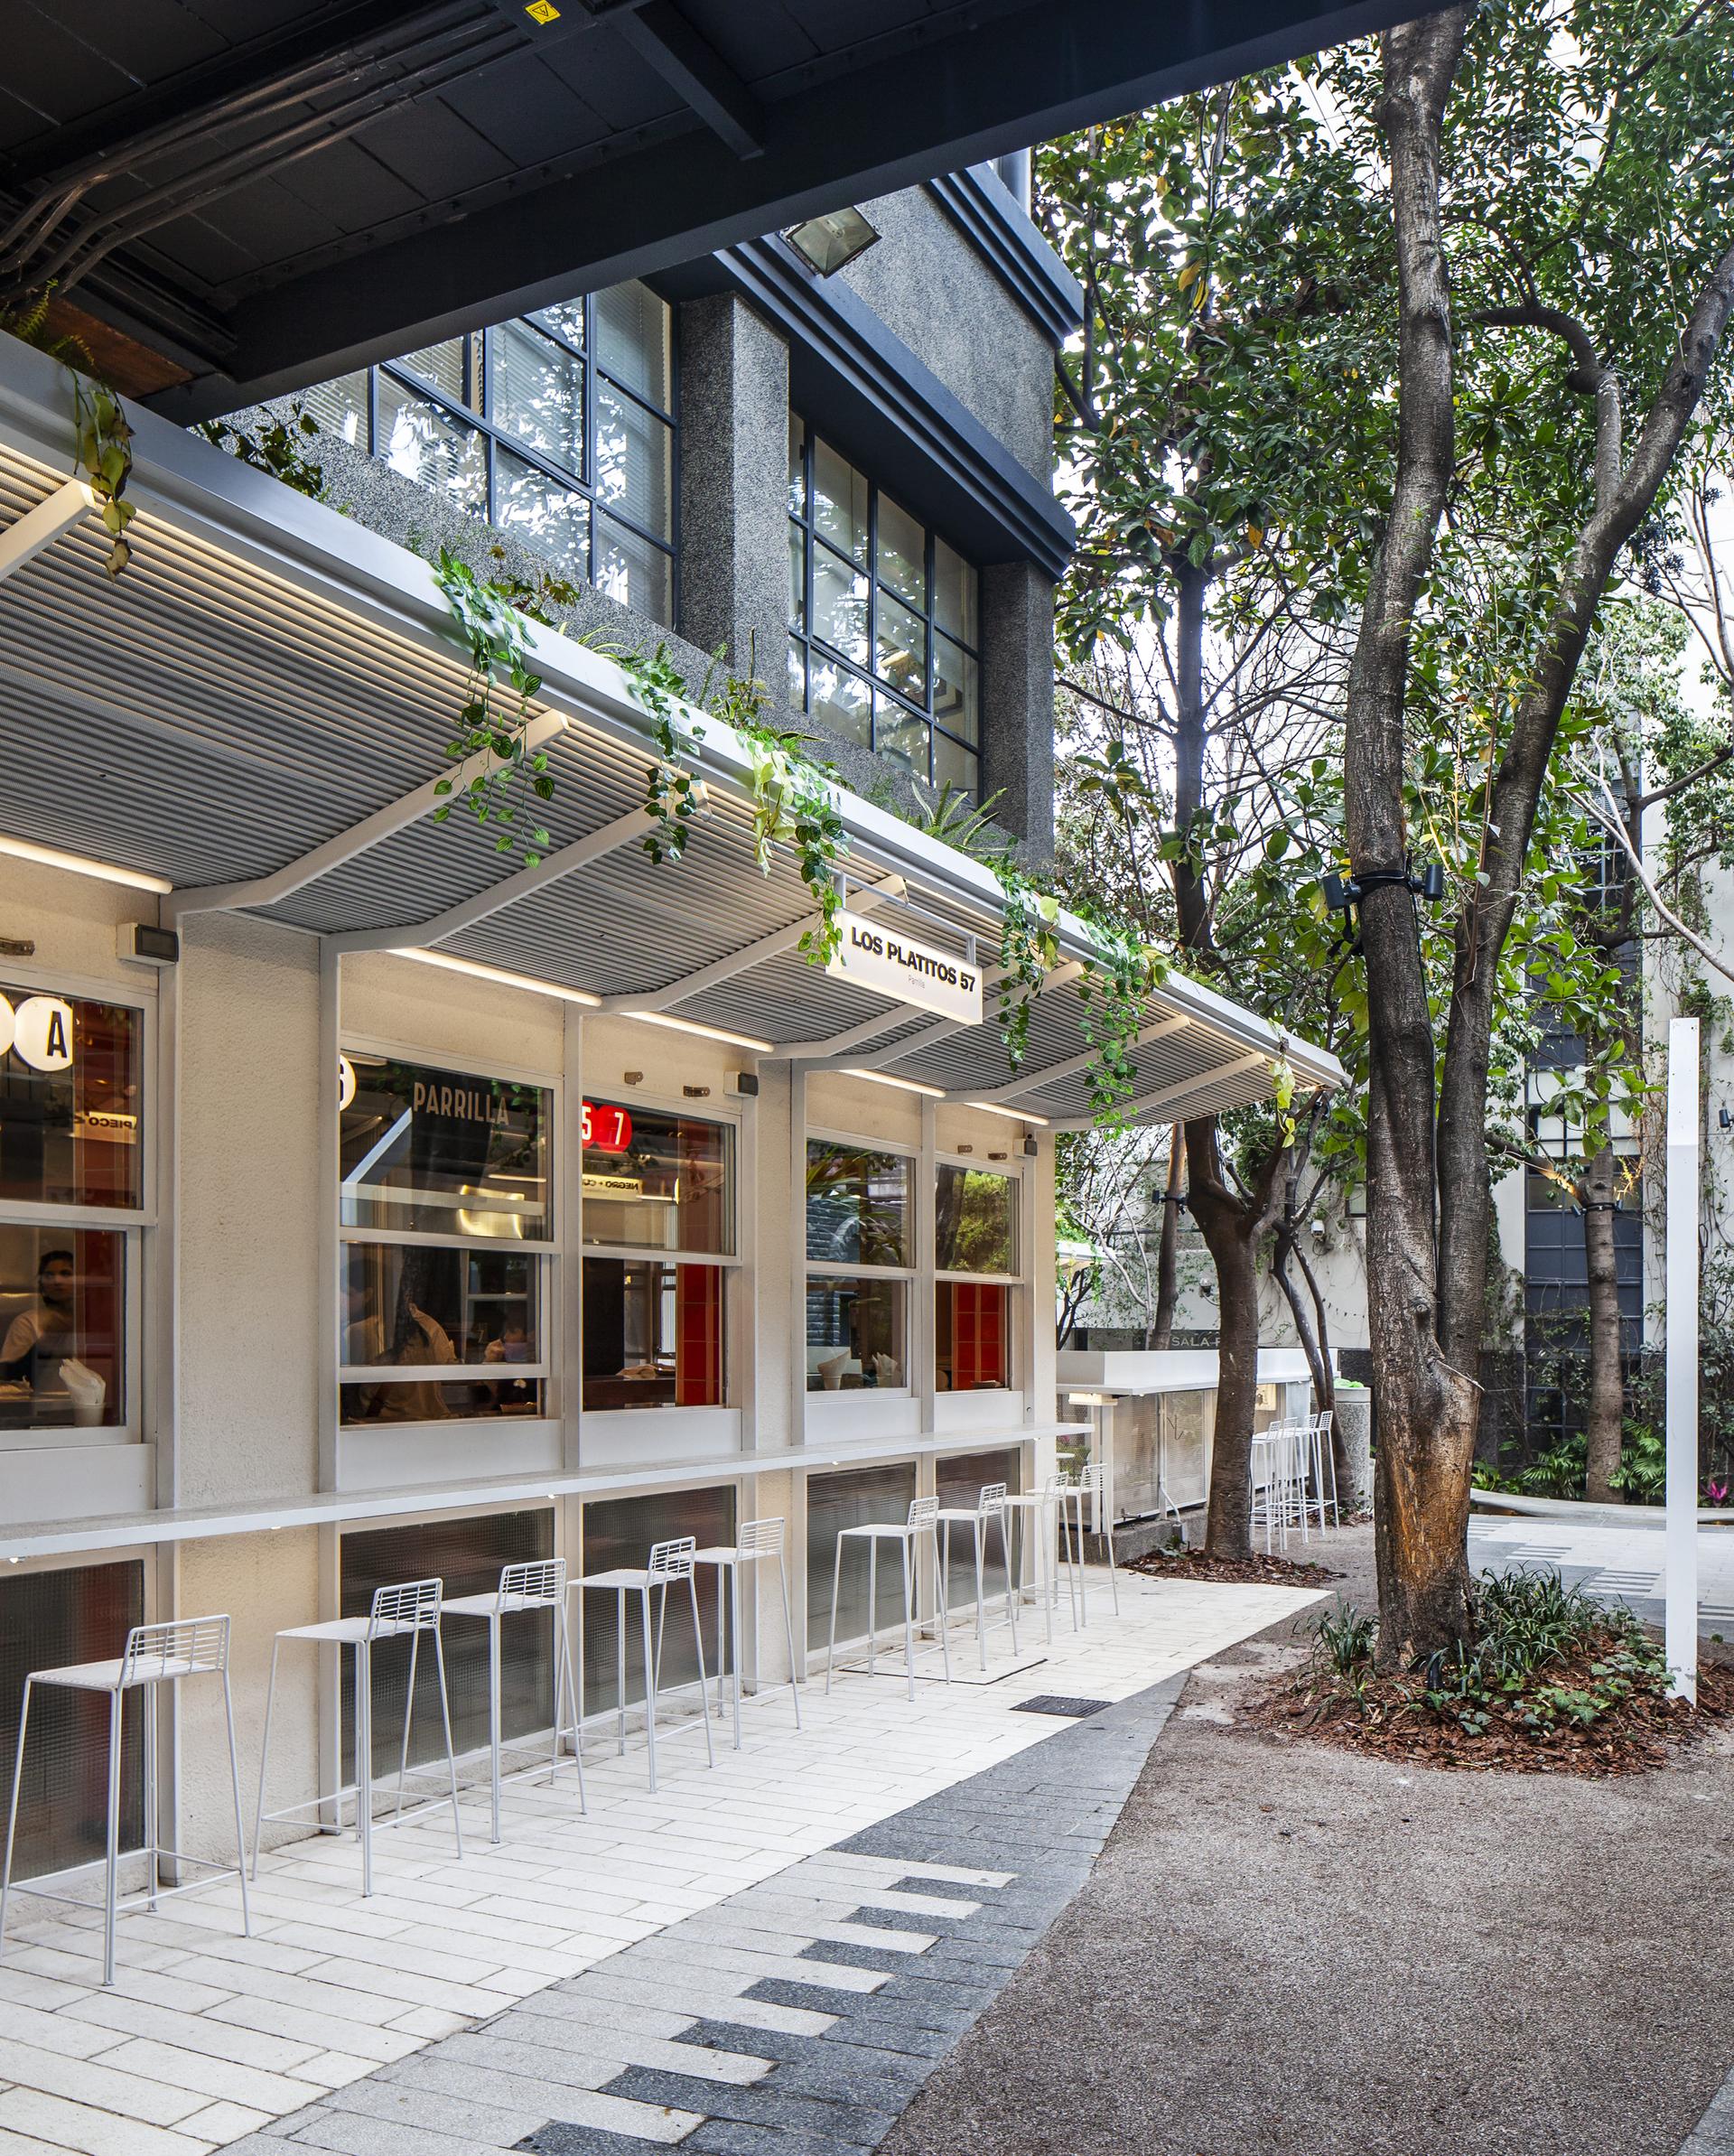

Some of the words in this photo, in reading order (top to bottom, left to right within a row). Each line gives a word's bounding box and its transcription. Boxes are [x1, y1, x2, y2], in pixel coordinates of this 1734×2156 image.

[852, 926, 883, 956] LOS
[887, 940, 957, 985] PLATITOS
[960, 971, 975, 993] 57
[47, 1011, 68, 1059] A
[414, 1082, 509, 1126] PARRILLA
[1171, 1337, 1210, 1347] SALA
